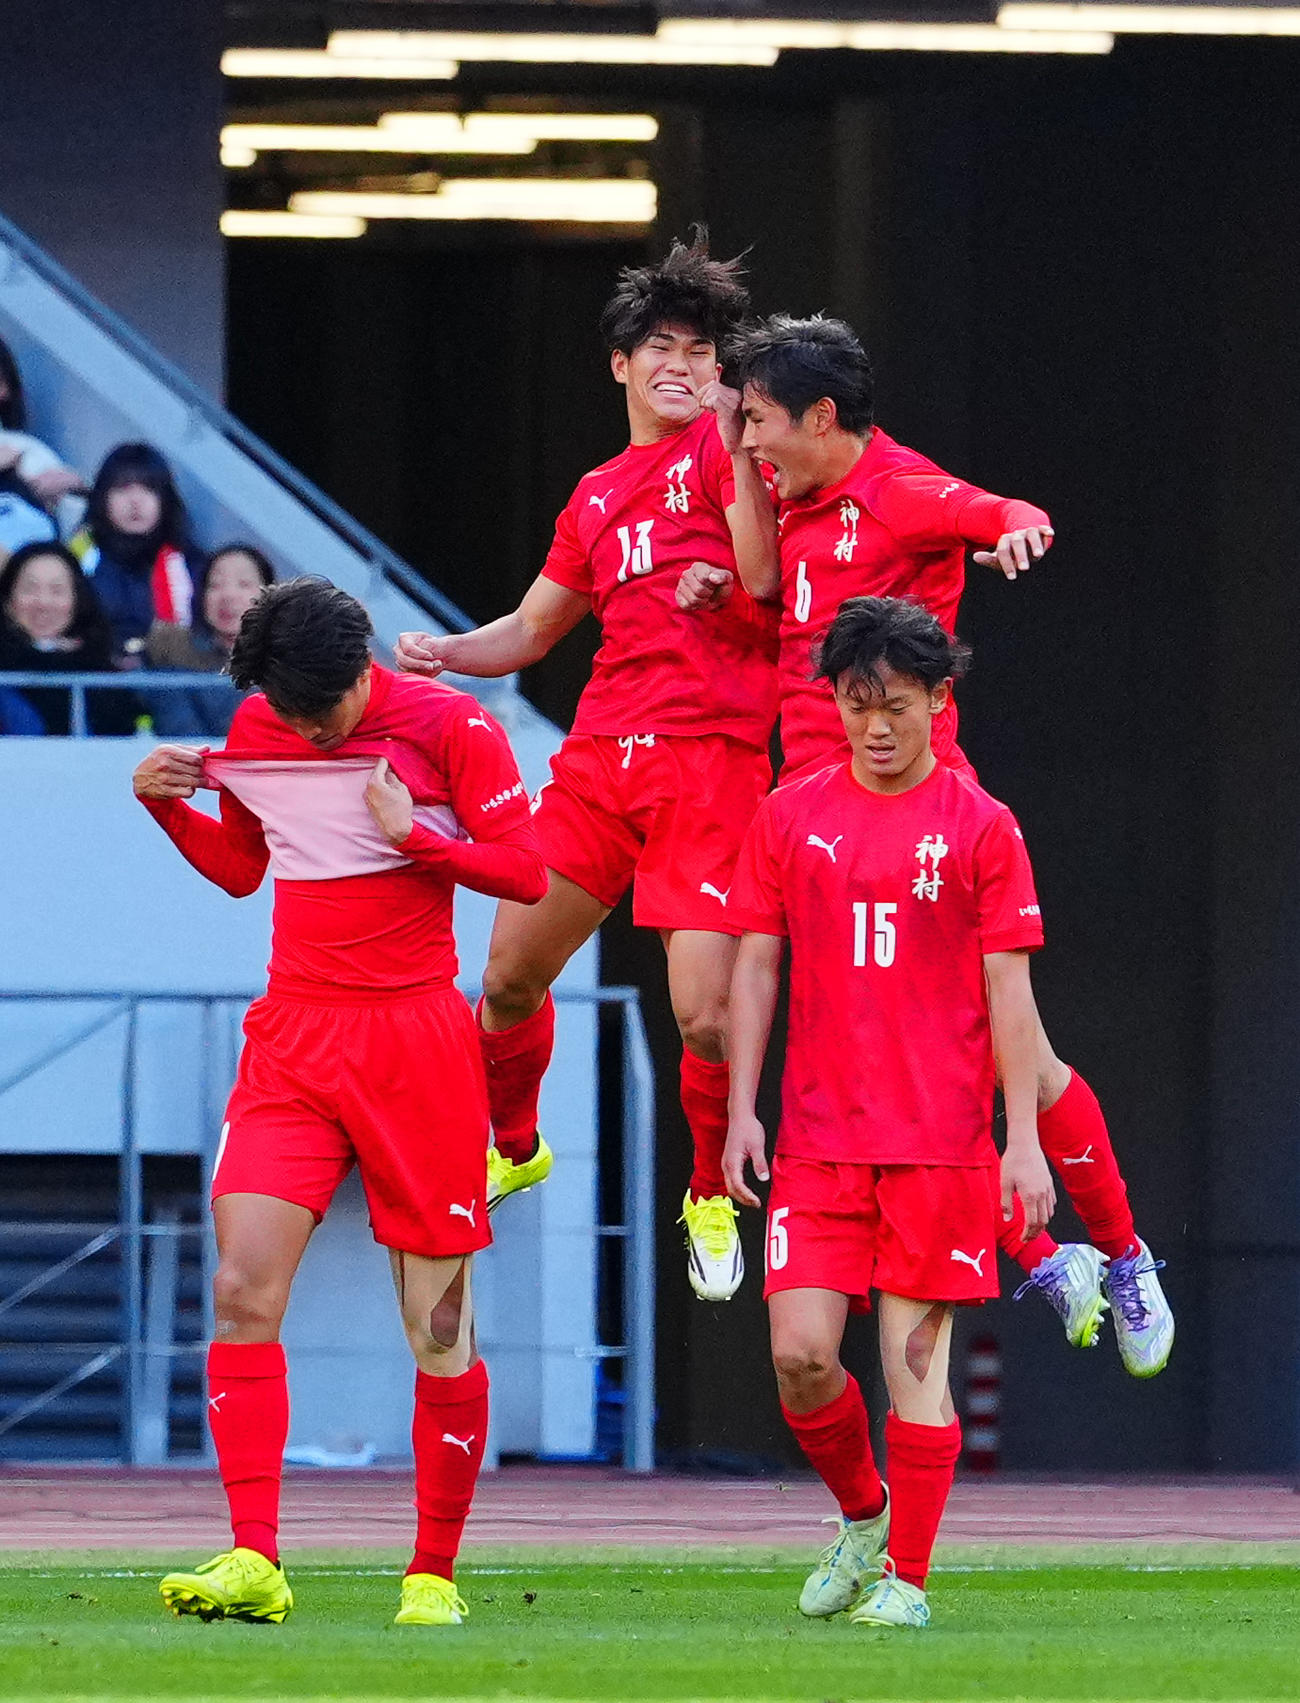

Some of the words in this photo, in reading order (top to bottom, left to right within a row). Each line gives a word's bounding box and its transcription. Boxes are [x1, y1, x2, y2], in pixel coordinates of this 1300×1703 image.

[663, 453, 693, 513] 神村
[616, 518, 655, 583] 13
[833, 498, 860, 563] 神村
[794, 560, 812, 623] 6
[911, 833, 949, 902] 神村
[852, 902, 898, 968] 15
[764, 1206, 790, 1276] 5
